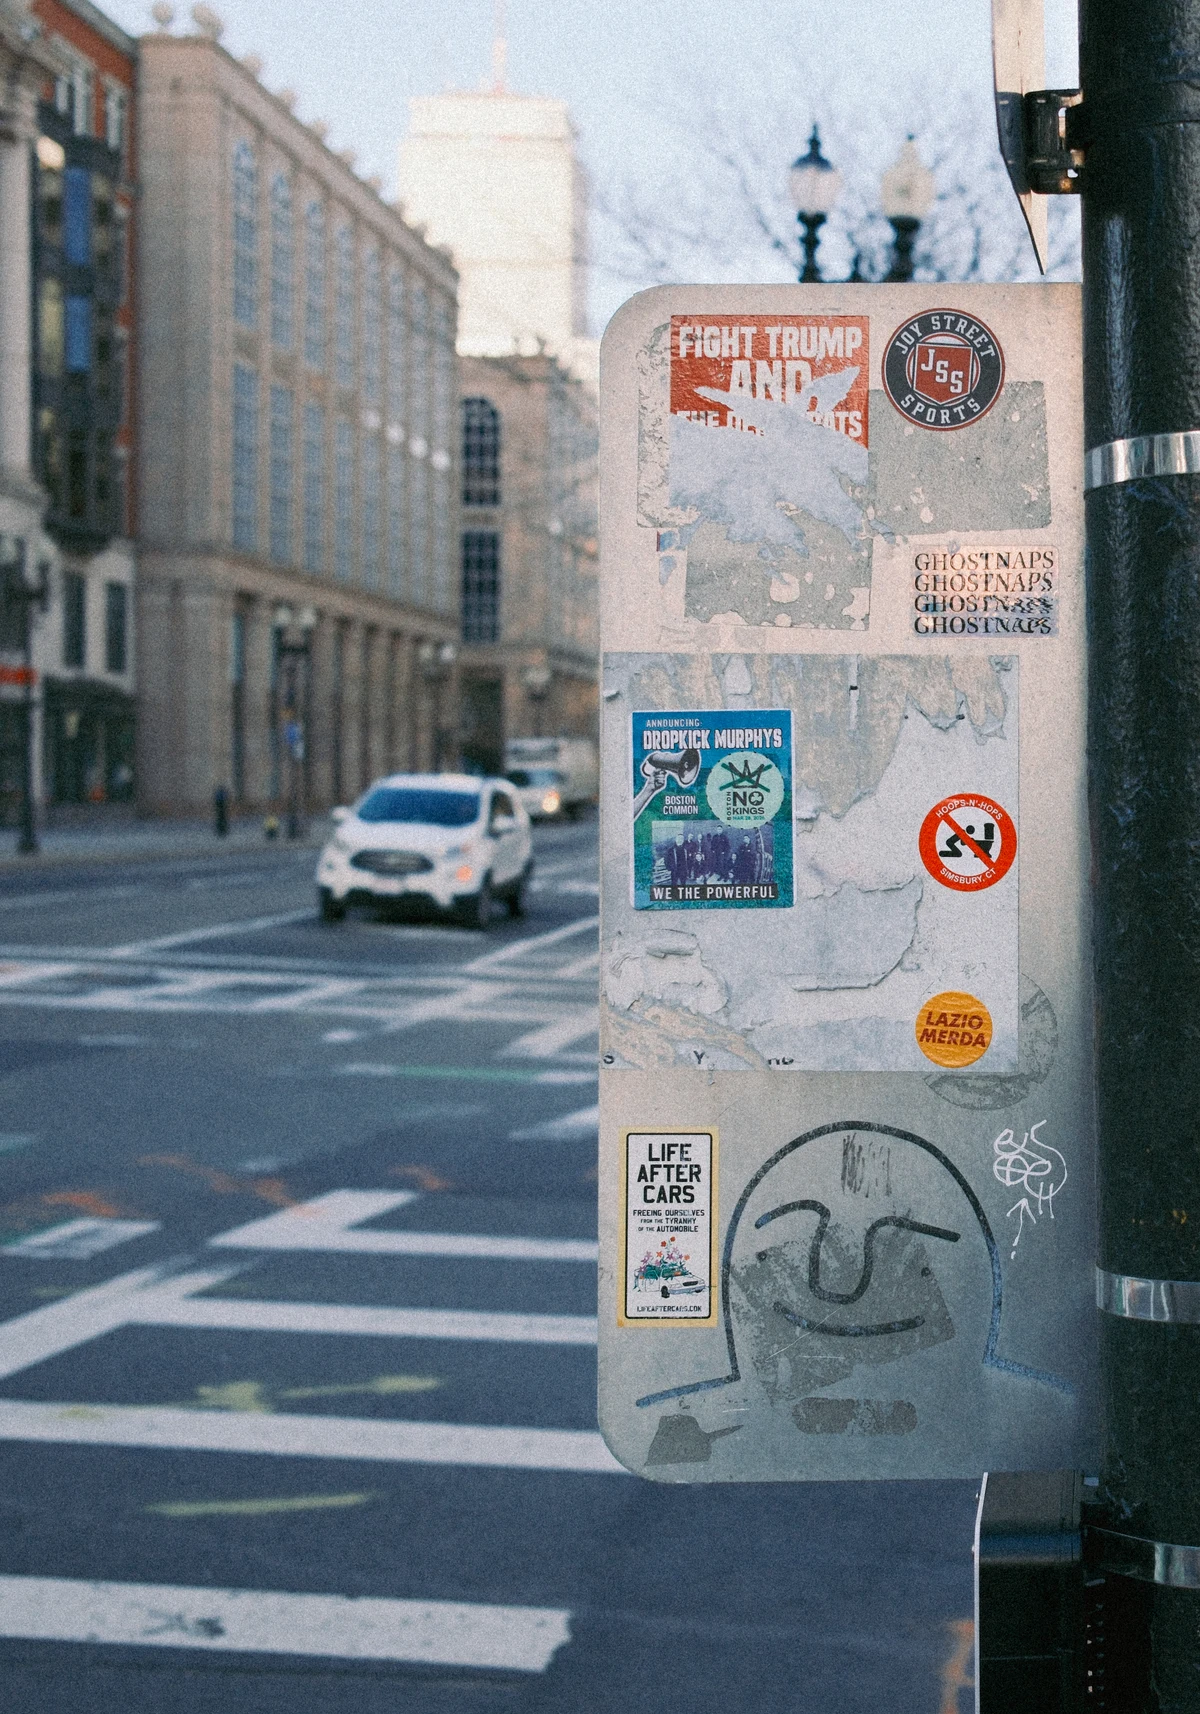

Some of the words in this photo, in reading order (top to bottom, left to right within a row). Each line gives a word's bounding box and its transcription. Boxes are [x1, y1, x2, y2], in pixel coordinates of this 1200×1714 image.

[679, 326, 756, 358] FIGHT
[765, 326, 863, 360] TRUMP
[895, 322, 922, 355] JOY
[931, 315, 995, 357] STREET
[730, 360, 812, 404] AND
[901, 394, 980, 424] SPORTS
[914, 551, 1054, 571] GHOSTNAPS
[914, 572, 1053, 592] GHOSTNAPS
[914, 616, 1052, 634] GHOSTNAPS
[643, 729, 710, 750] DROPKICK
[714, 728, 783, 749] MURPHYS
[665, 795, 696, 805] BOSTON
[733, 791, 764, 806] NO
[663, 805, 698, 815] COMMON
[732, 807, 765, 815] KINGS
[985, 868, 996, 878] CT
[653, 887, 672, 899] WE
[678, 887, 700, 899] THE
[706, 886, 775, 899] POWERFUL
[926, 1011, 983, 1030] LAZIO
[919, 1028, 986, 1047] MERDA
[648, 1143, 692, 1161] LIFE
[637, 1164, 701, 1182] AFTER
[643, 1185, 695, 1203] CARS
[656, 1225, 698, 1233] AUTOMOBILE
